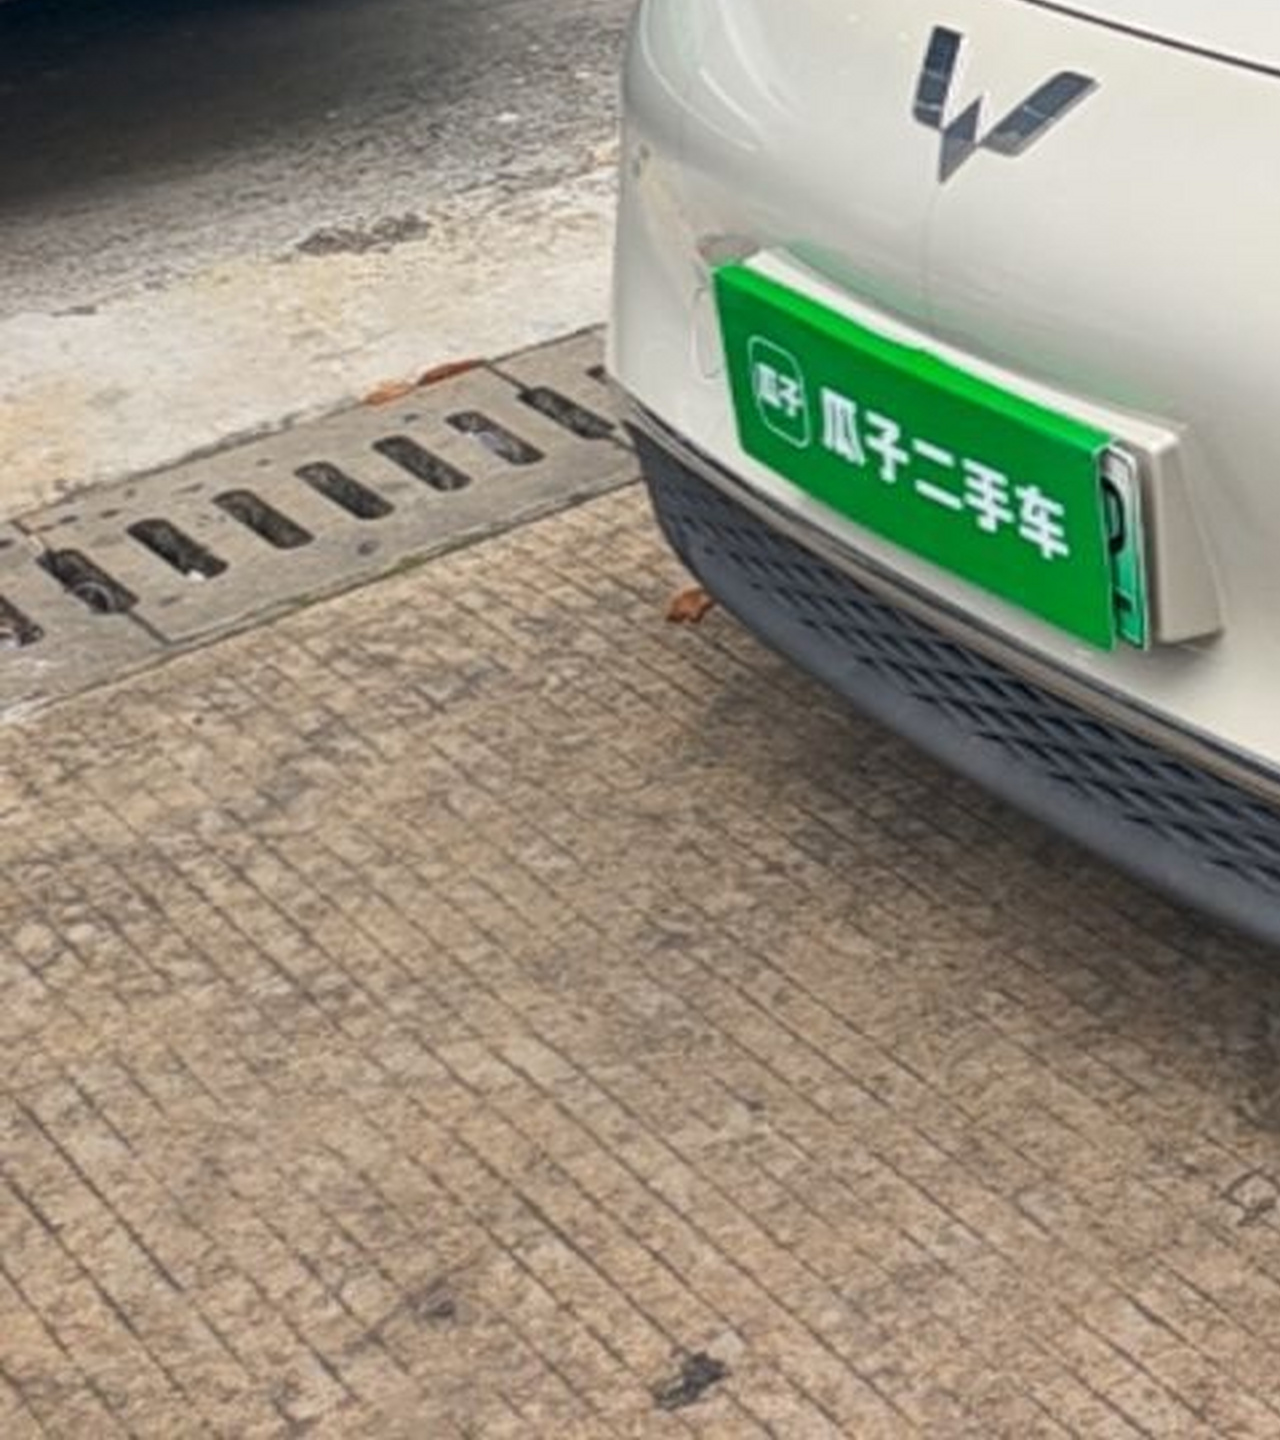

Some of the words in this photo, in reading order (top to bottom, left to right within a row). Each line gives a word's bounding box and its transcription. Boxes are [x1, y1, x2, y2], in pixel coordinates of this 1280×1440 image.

[752, 360, 806, 420] 瓜子
[819, 386, 1071, 561] 瓜子二手车
